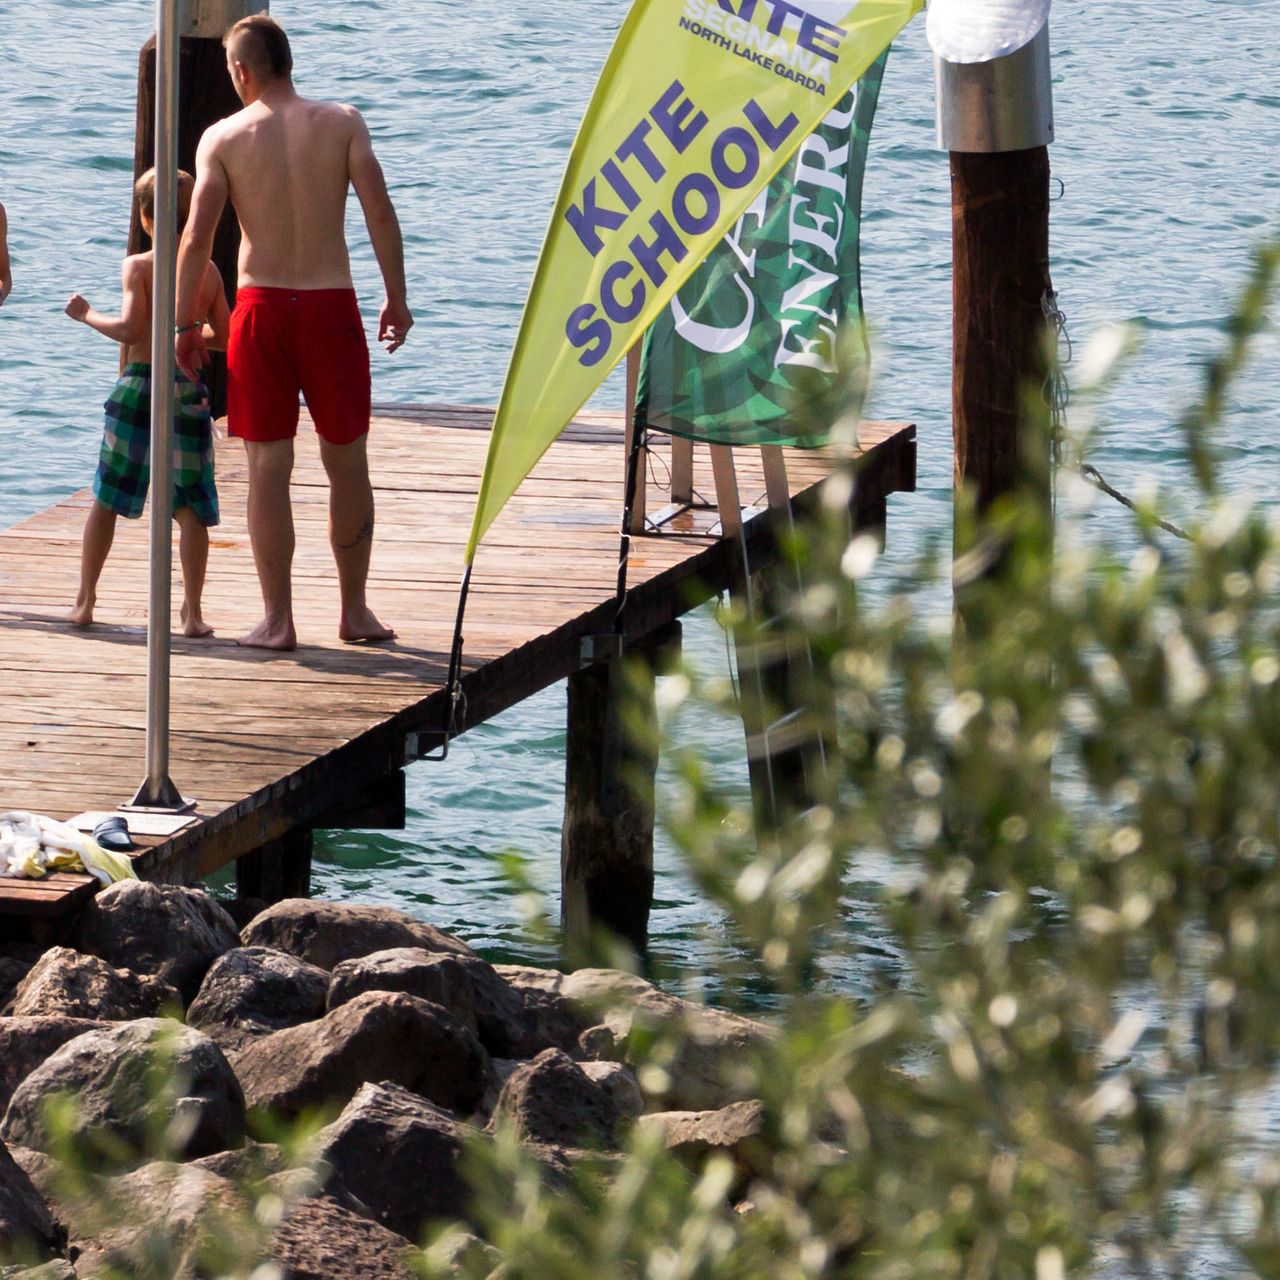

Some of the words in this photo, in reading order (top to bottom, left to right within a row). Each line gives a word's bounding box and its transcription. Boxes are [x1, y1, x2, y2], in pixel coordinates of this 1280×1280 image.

[679, 16, 732, 51] NORTH
[732, 43, 775, 71] LAKE
[773, 63, 827, 97] GARDA
[565, 79, 710, 258] KITE
[565, 98, 801, 367] SCHOOL
